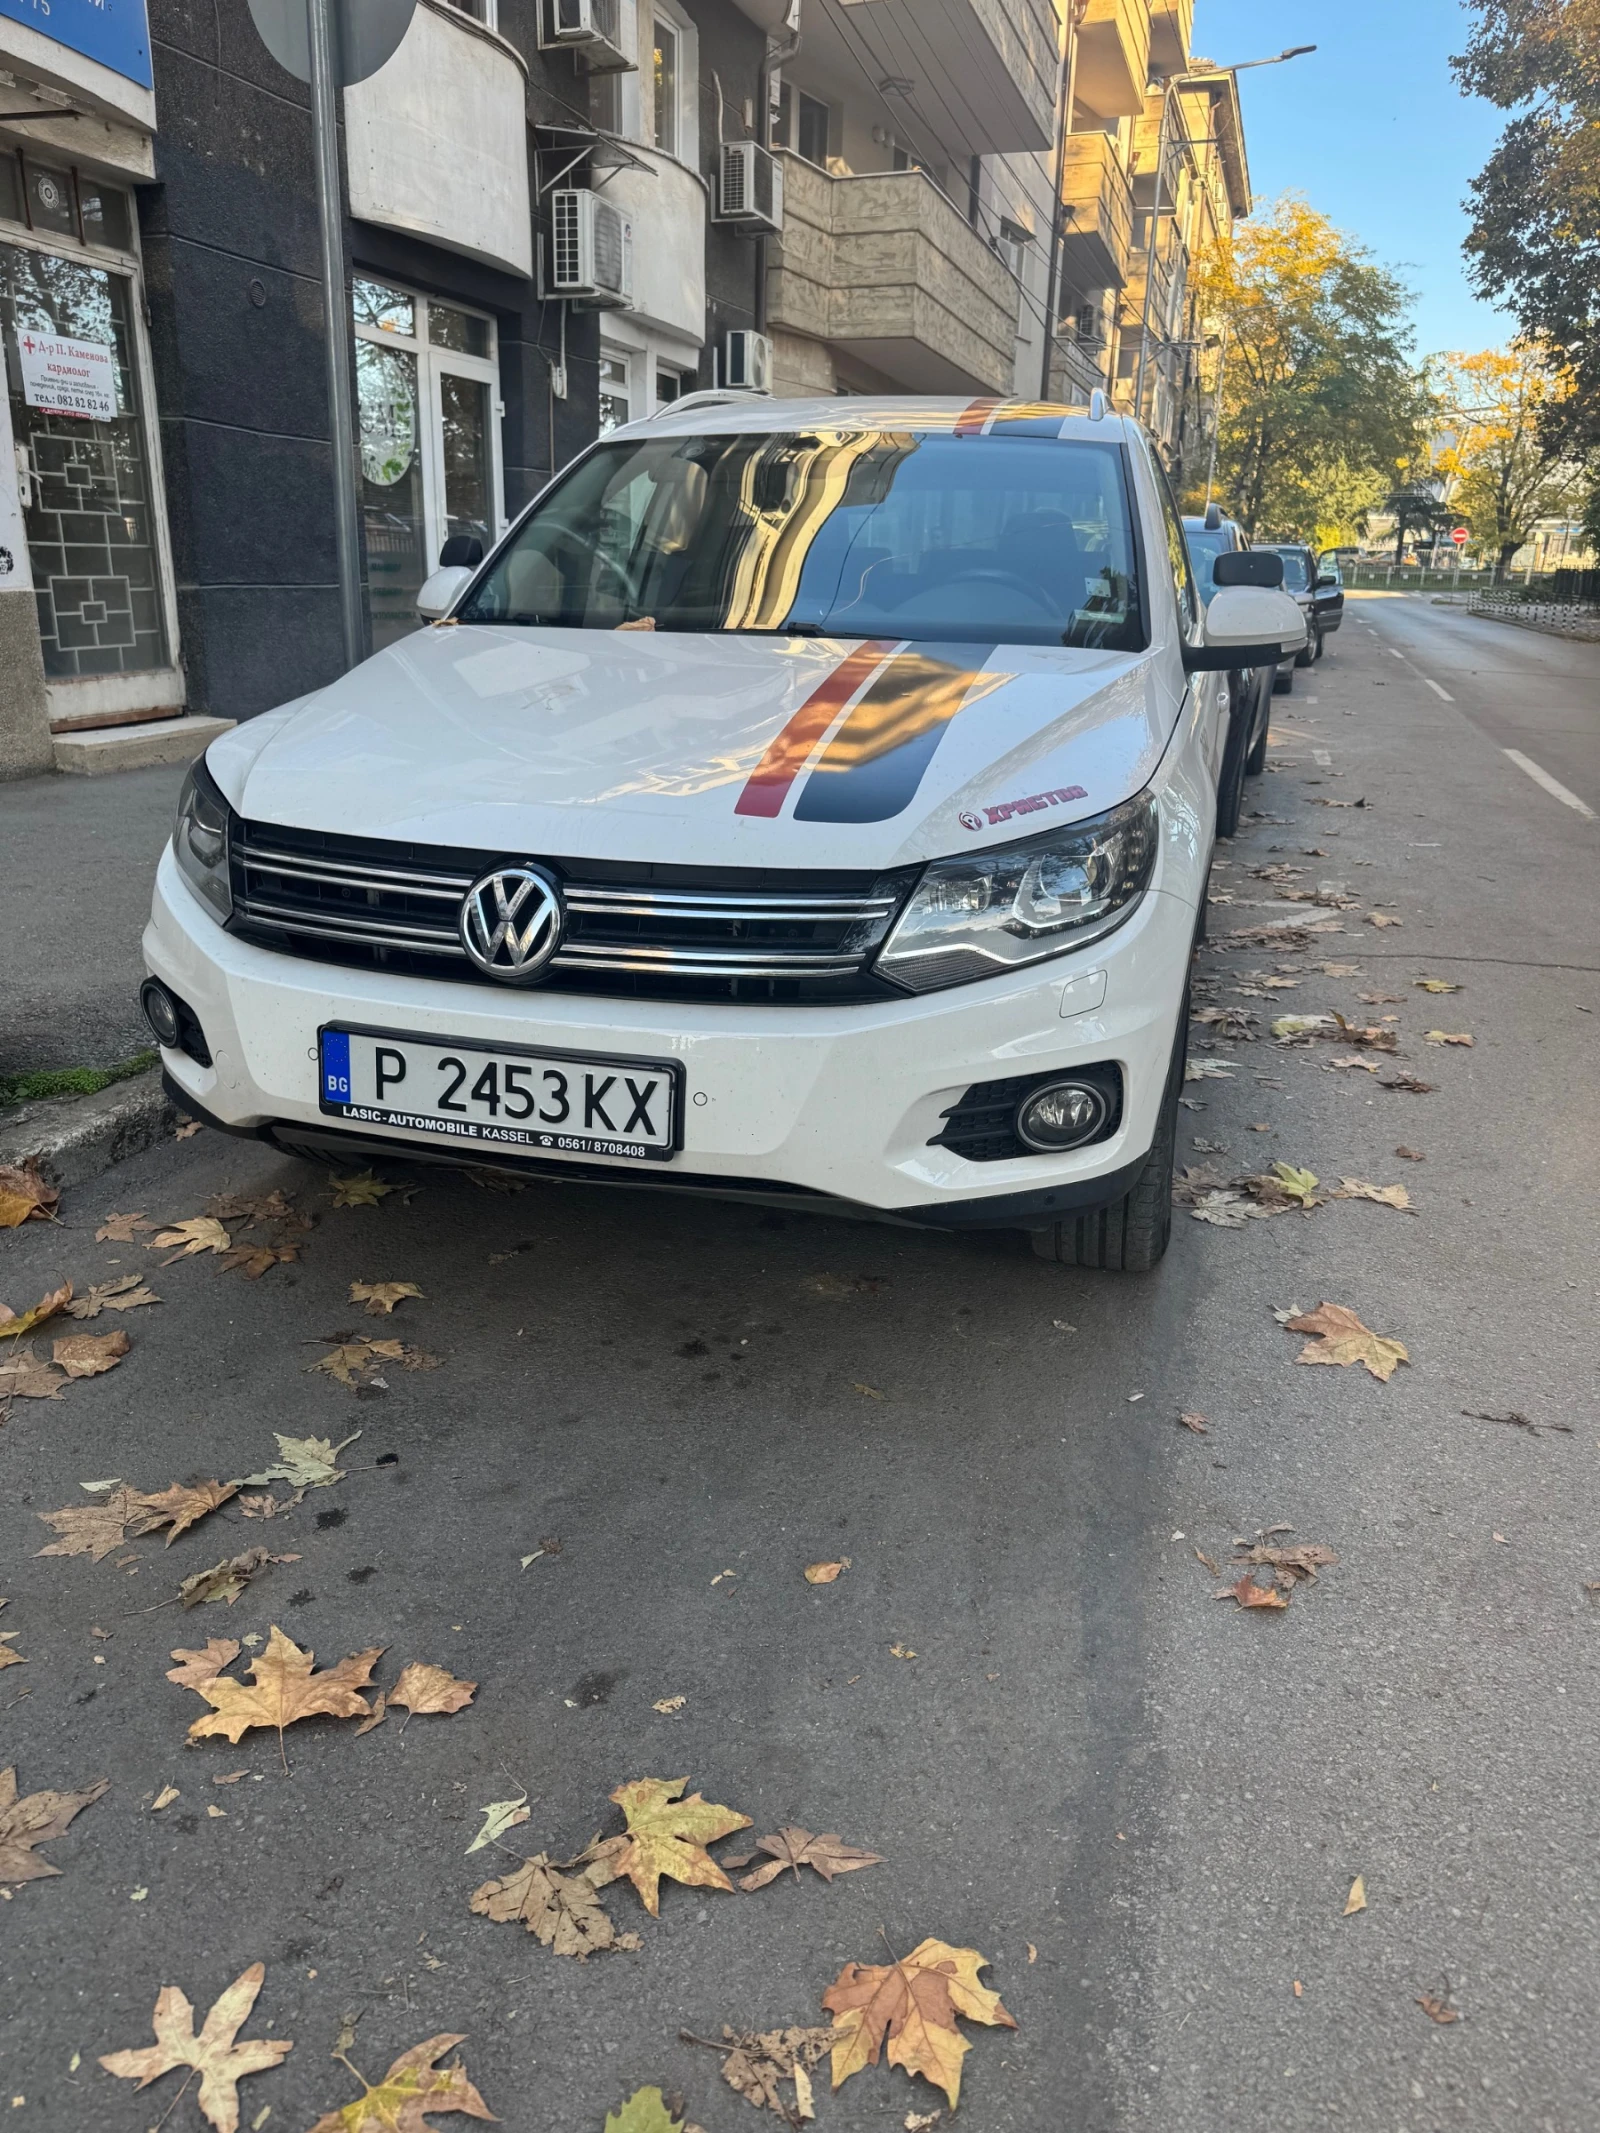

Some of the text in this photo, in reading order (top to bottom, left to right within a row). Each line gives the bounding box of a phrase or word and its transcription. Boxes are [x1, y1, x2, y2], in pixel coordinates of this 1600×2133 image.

[38, 341, 108, 363] Д-р П. Каменова
[47, 363, 90, 377] кардиолог
[57, 394, 73, 407] 082
[75, 397, 86, 408] 82
[87, 399, 98, 410] 82
[99, 401, 110, 412] 46
[328, 1075, 348, 1093] BG
[437, 1056, 570, 1124] 2453
[482, 1127, 534, 1144] KASSEL
